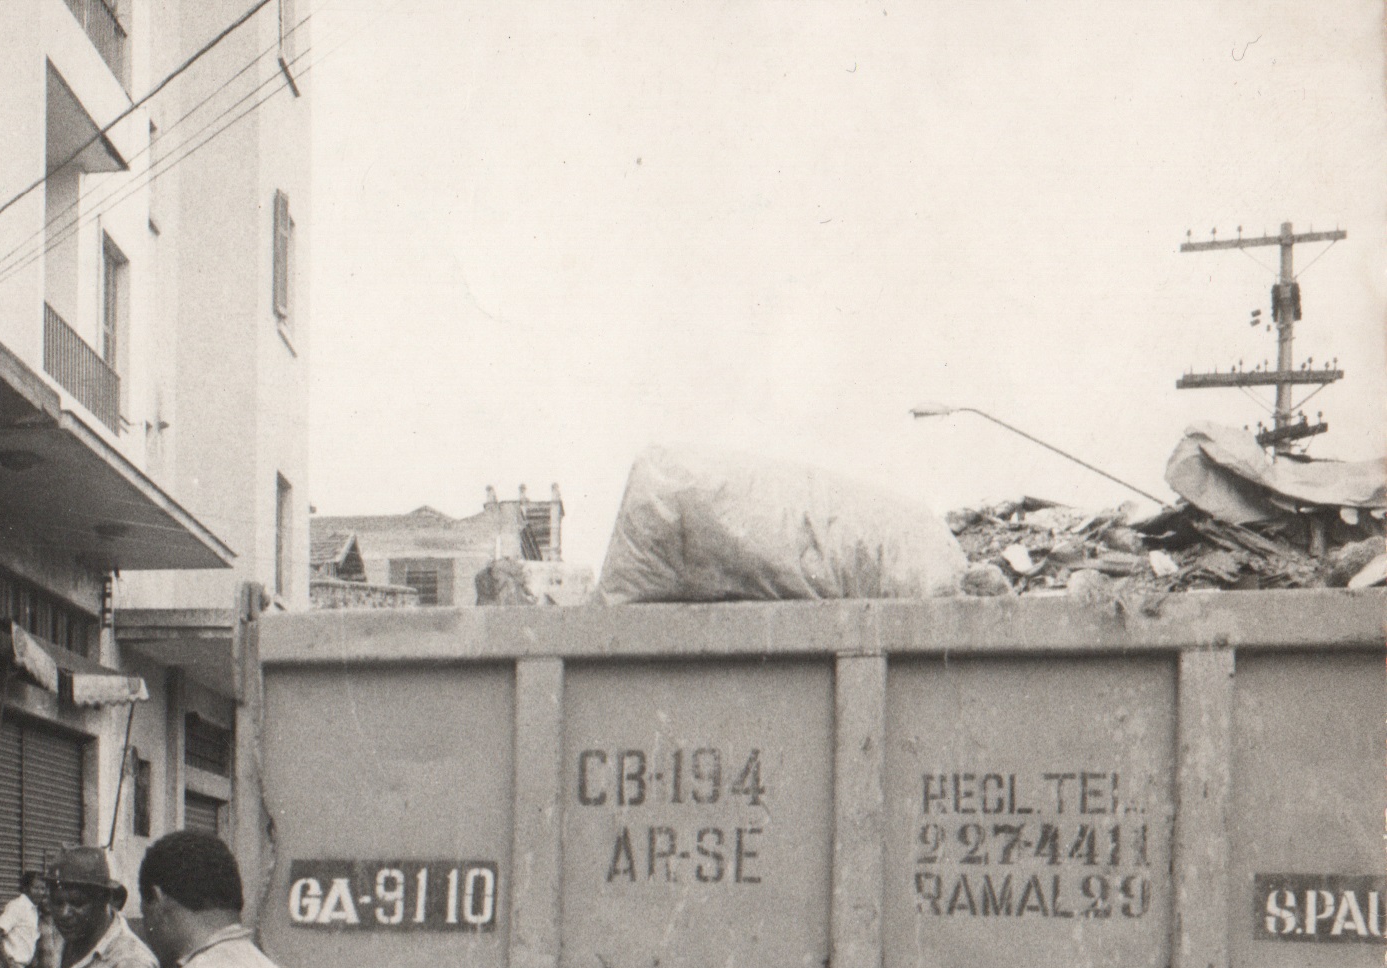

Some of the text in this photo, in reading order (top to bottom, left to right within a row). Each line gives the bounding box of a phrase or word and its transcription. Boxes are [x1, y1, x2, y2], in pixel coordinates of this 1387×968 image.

[577, 747, 768, 809] CB-194
[606, 825, 763, 885] AR-SE
[916, 822, 1151, 867] 227-4411
[288, 867, 496, 927] GA-9110
[914, 871, 1075, 918] RAMAL
